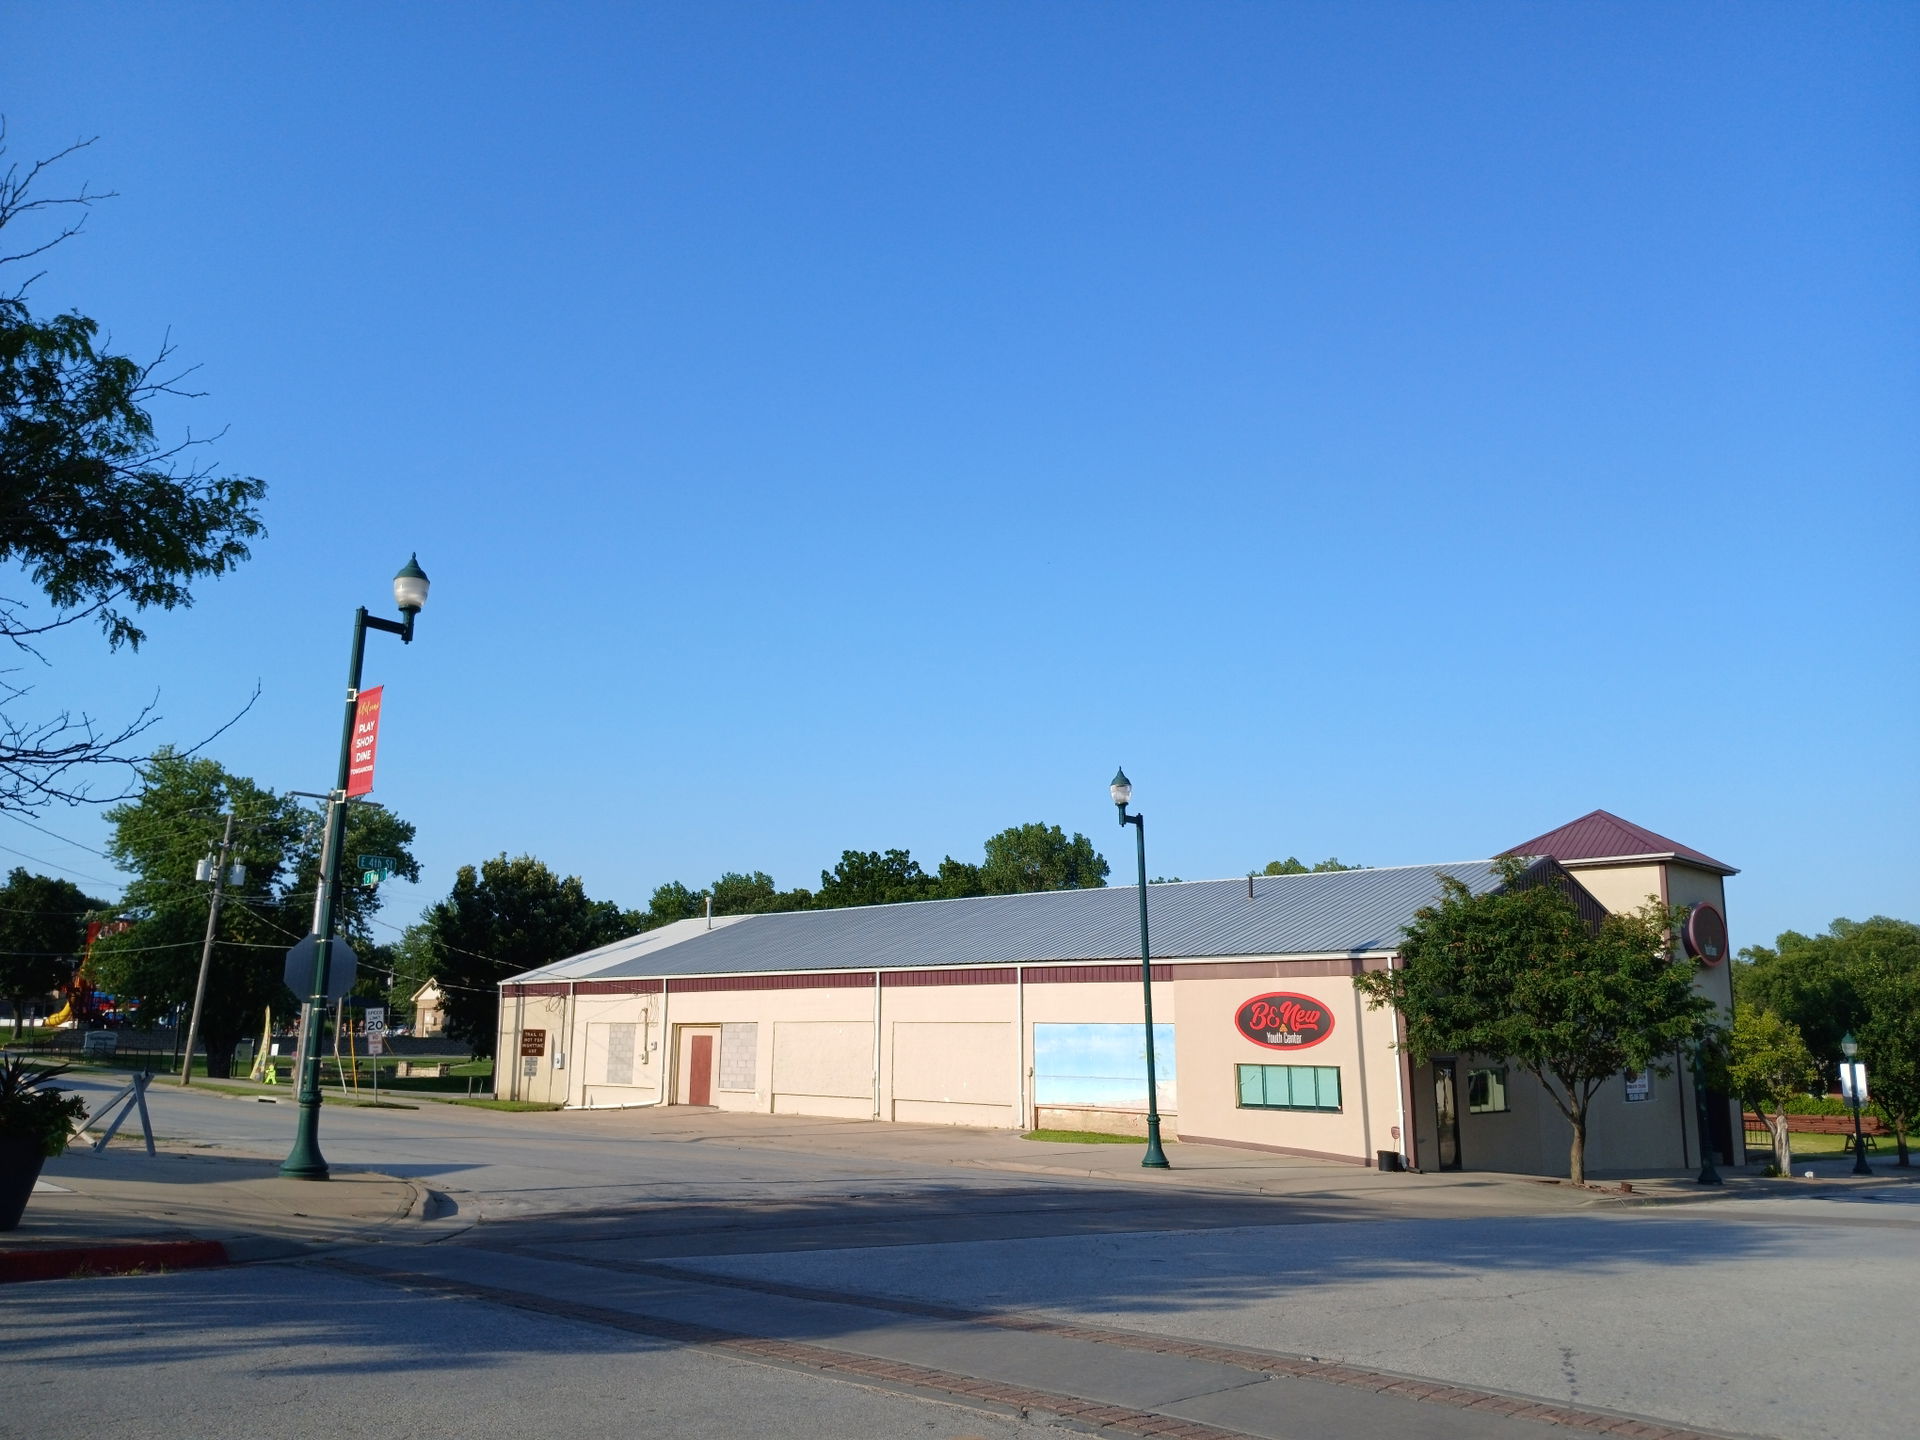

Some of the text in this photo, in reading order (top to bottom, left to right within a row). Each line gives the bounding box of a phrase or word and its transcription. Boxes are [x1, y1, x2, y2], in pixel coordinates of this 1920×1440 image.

[359, 721, 375, 734] PLAY
[356, 736, 374, 749] SHOP
[356, 750, 371, 763] DINE
[369, 857, 382, 868] 4th
[367, 1020, 383, 1031] 20
[1266, 1031, 1302, 1044] Youth Center
